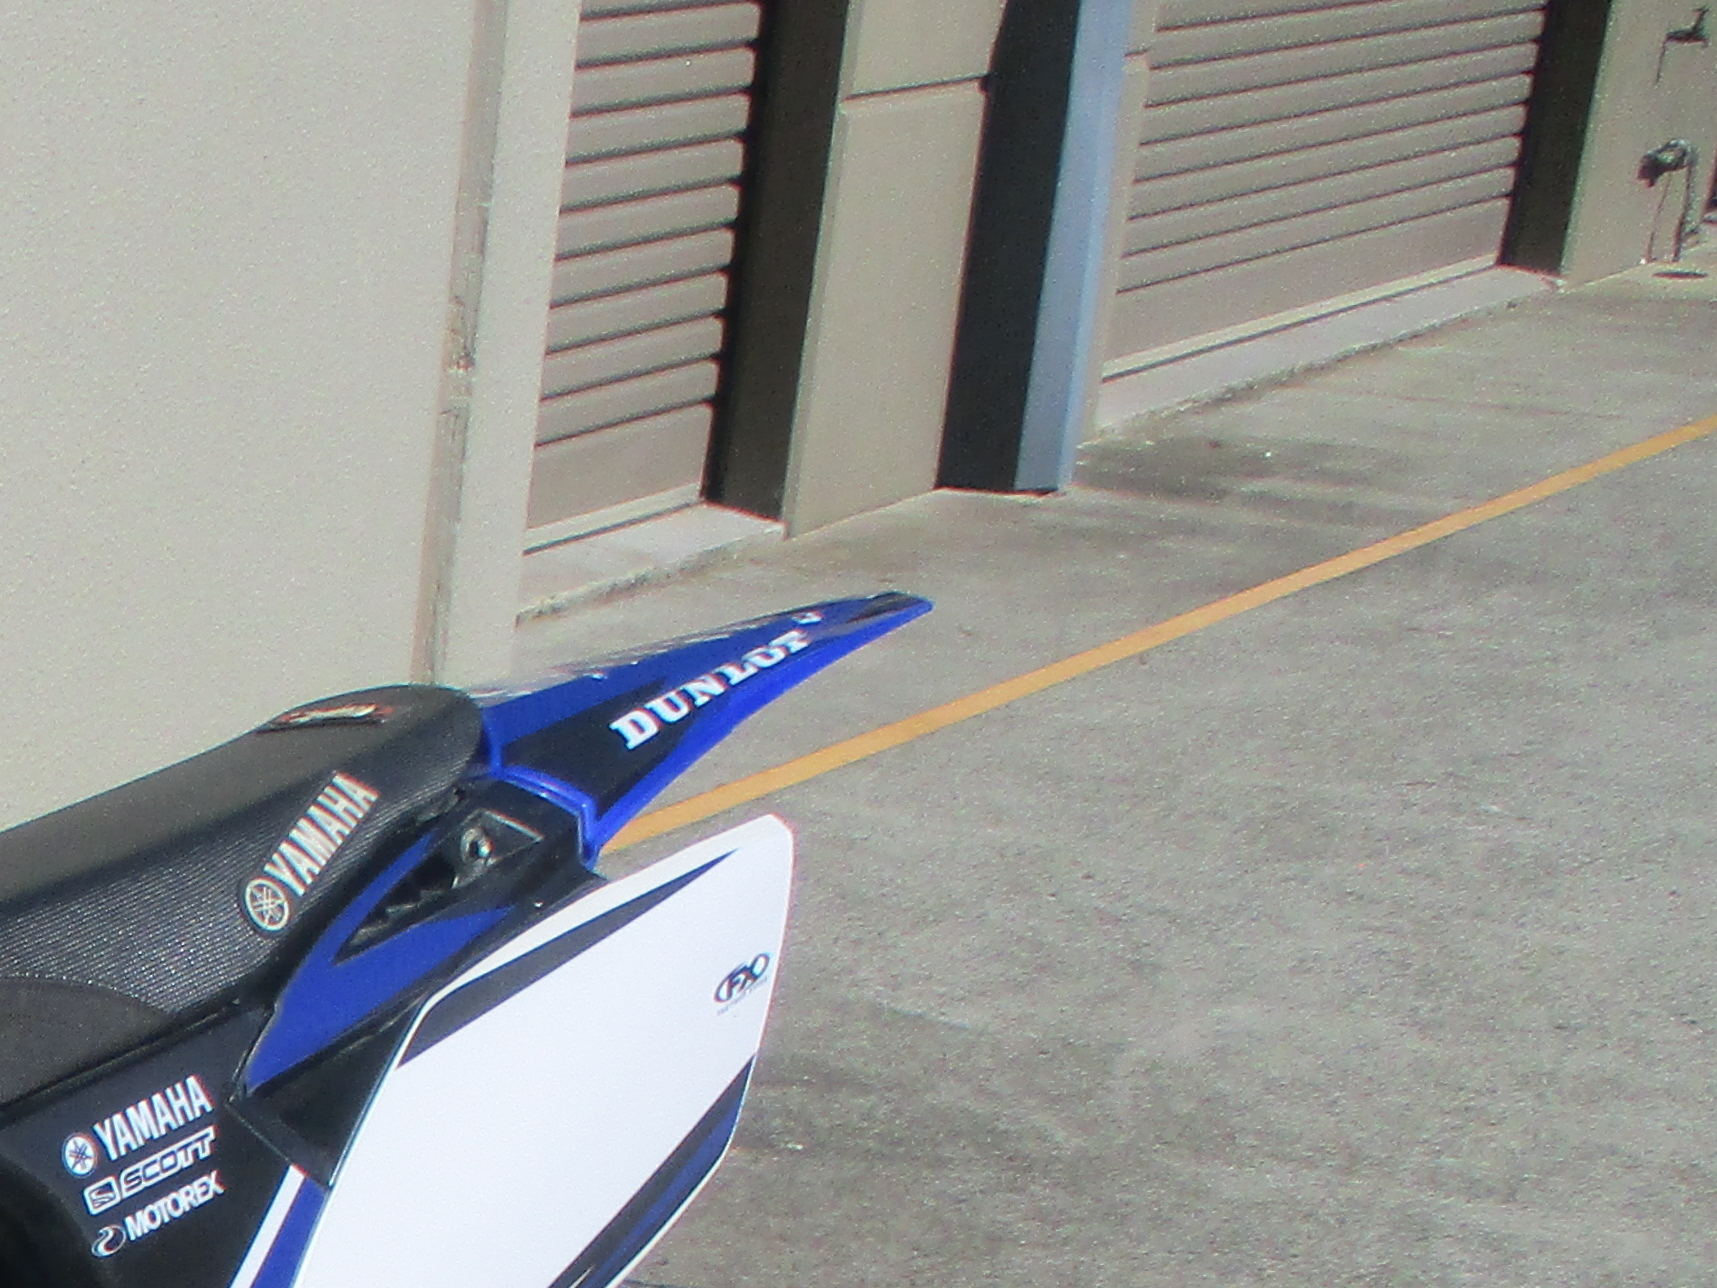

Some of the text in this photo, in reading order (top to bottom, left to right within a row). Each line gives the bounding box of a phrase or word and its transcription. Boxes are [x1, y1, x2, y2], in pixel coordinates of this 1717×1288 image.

[263, 771, 381, 897] YAMAHA
[93, 1074, 216, 1161] YAMAHA
[120, 1125, 218, 1199] SCOTT
[124, 1171, 226, 1241] MOTOREX
